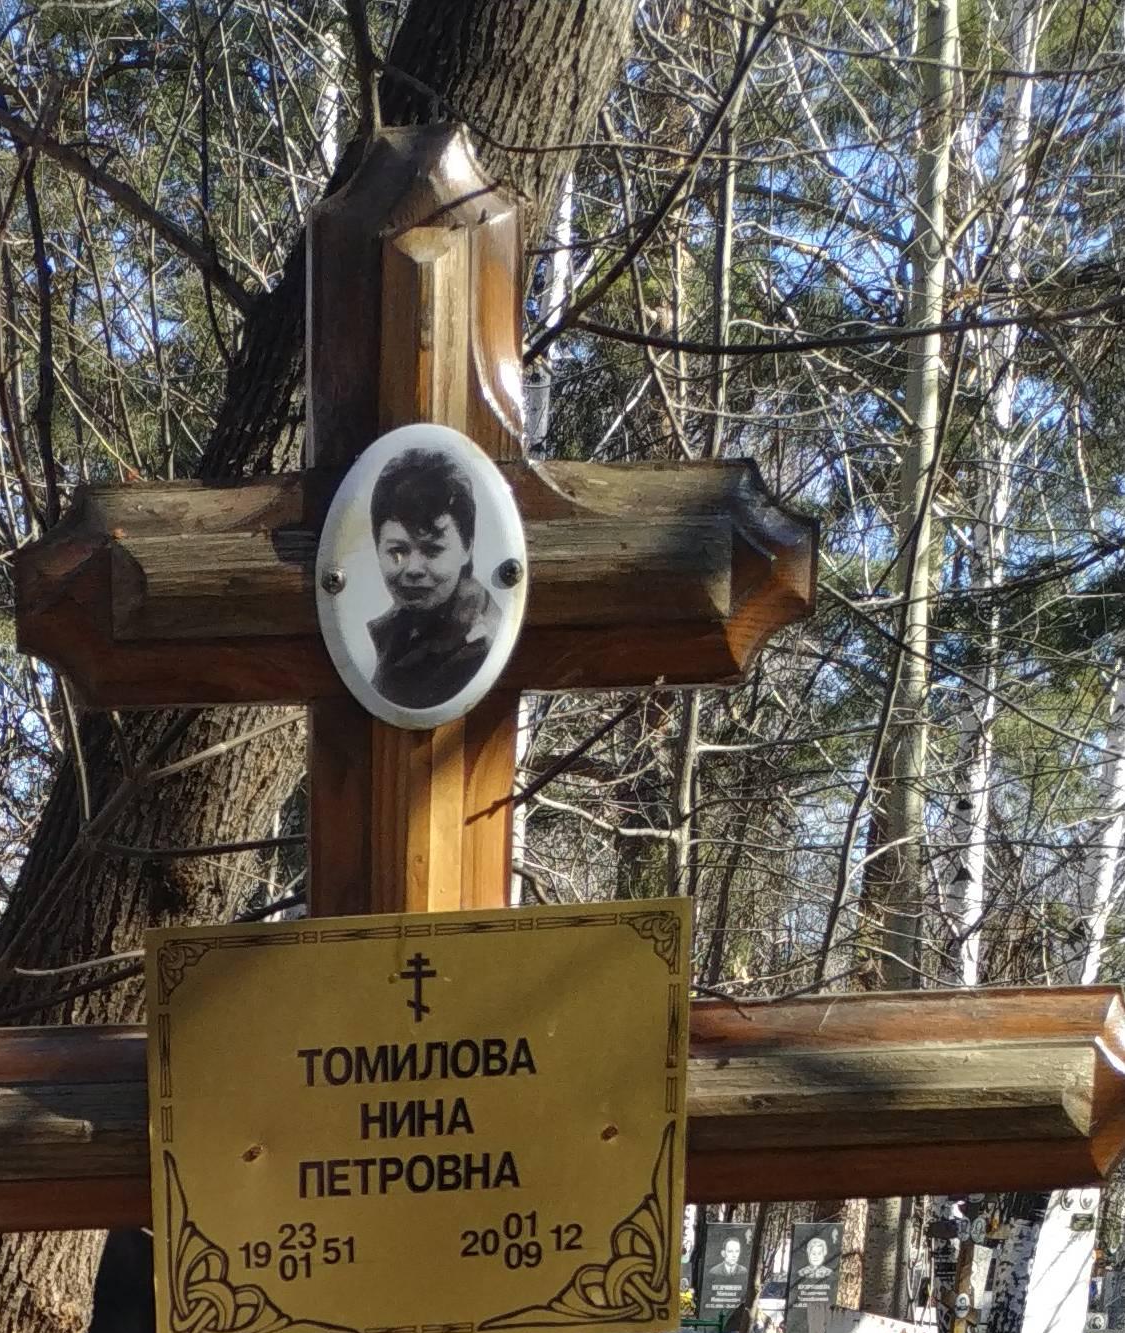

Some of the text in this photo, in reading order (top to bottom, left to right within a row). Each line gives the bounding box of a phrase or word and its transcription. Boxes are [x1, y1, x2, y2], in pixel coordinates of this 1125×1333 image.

[297, 1038, 537, 1086] ТОМИЛОВА
[360, 1097, 474, 1140] НИНА
[299, 1152, 520, 1198] ПЕТРОВНА
[239, 1223, 357, 1281] 19 23 01 51
[461, 1212, 583, 1269] 20 01 09 12
